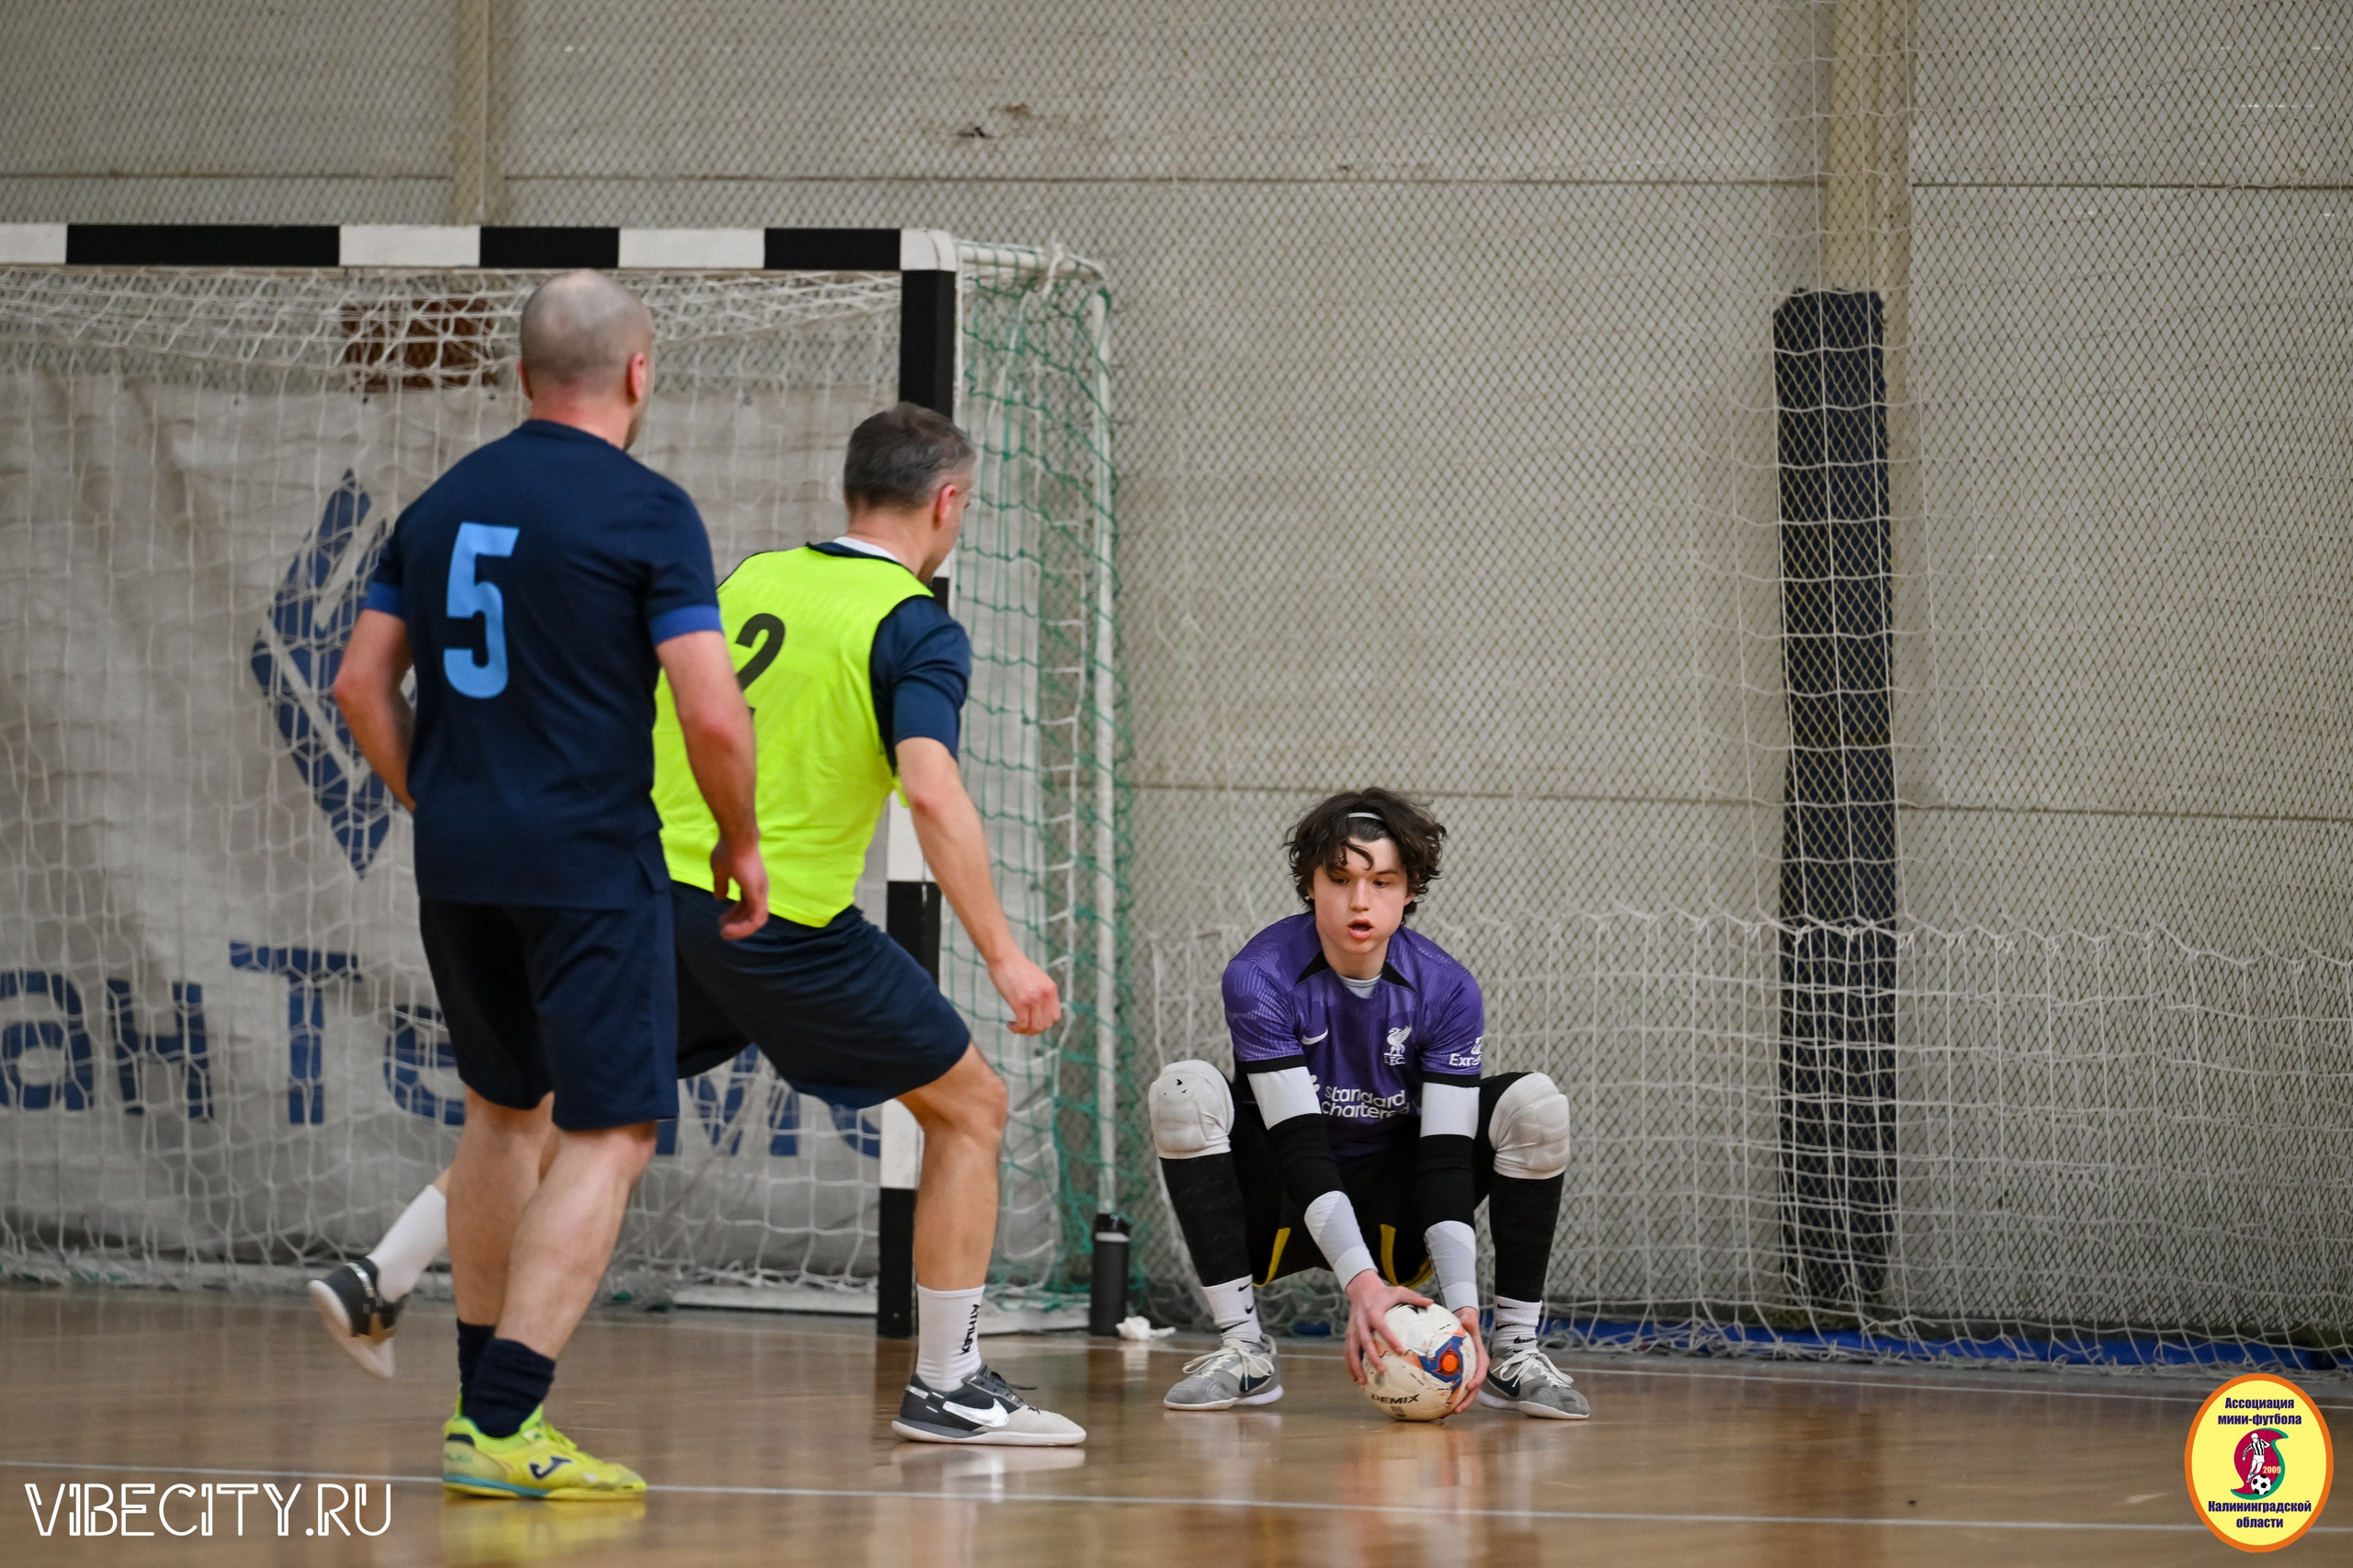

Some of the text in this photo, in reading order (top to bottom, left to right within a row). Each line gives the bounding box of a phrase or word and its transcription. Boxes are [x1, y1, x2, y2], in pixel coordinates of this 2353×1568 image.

[443, 521, 519, 699] 5
[734, 613, 786, 717] 2
[1370, 1392, 1420, 1404] DEMIX
